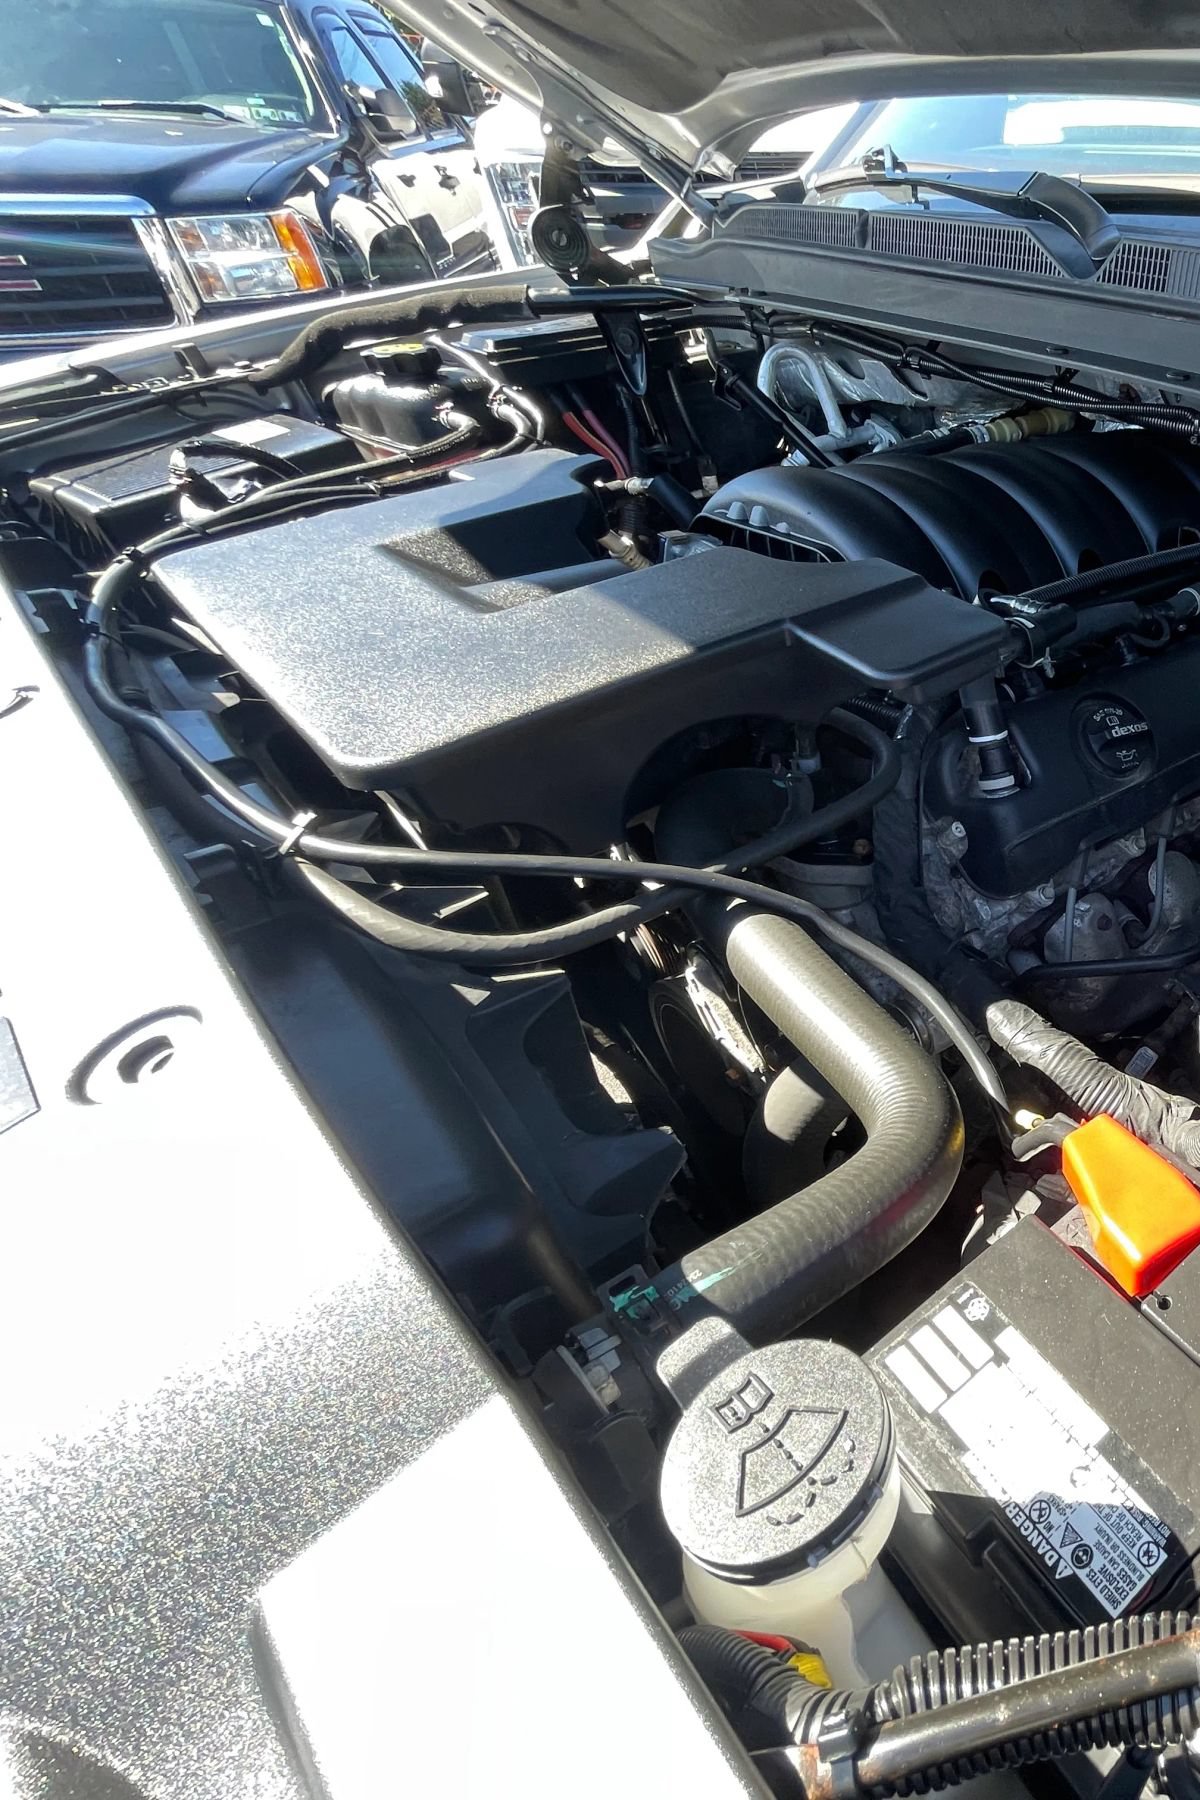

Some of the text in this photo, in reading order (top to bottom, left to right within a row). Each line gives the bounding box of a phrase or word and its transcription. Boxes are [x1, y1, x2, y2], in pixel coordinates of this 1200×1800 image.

[1112, 722, 1148, 738] dexos
[1102, 1511, 1113, 1521] OF
[1042, 1520, 1054, 1533] NO
[1109, 1518, 1124, 1534] OUT
[1115, 1510, 1143, 1541] REACH OF
[1157, 1523, 1171, 1537] NOT
[1109, 1541, 1120, 1552] OR
[1120, 1531, 1136, 1549] KEEP
[1092, 1539, 1137, 1591] GASES CAN CAUSE
[1116, 1550, 1144, 1581] BLINDNESS
[1097, 1563, 1129, 1600] EXPLOSIVE
[1098, 1584, 1122, 1609] SHIELD
